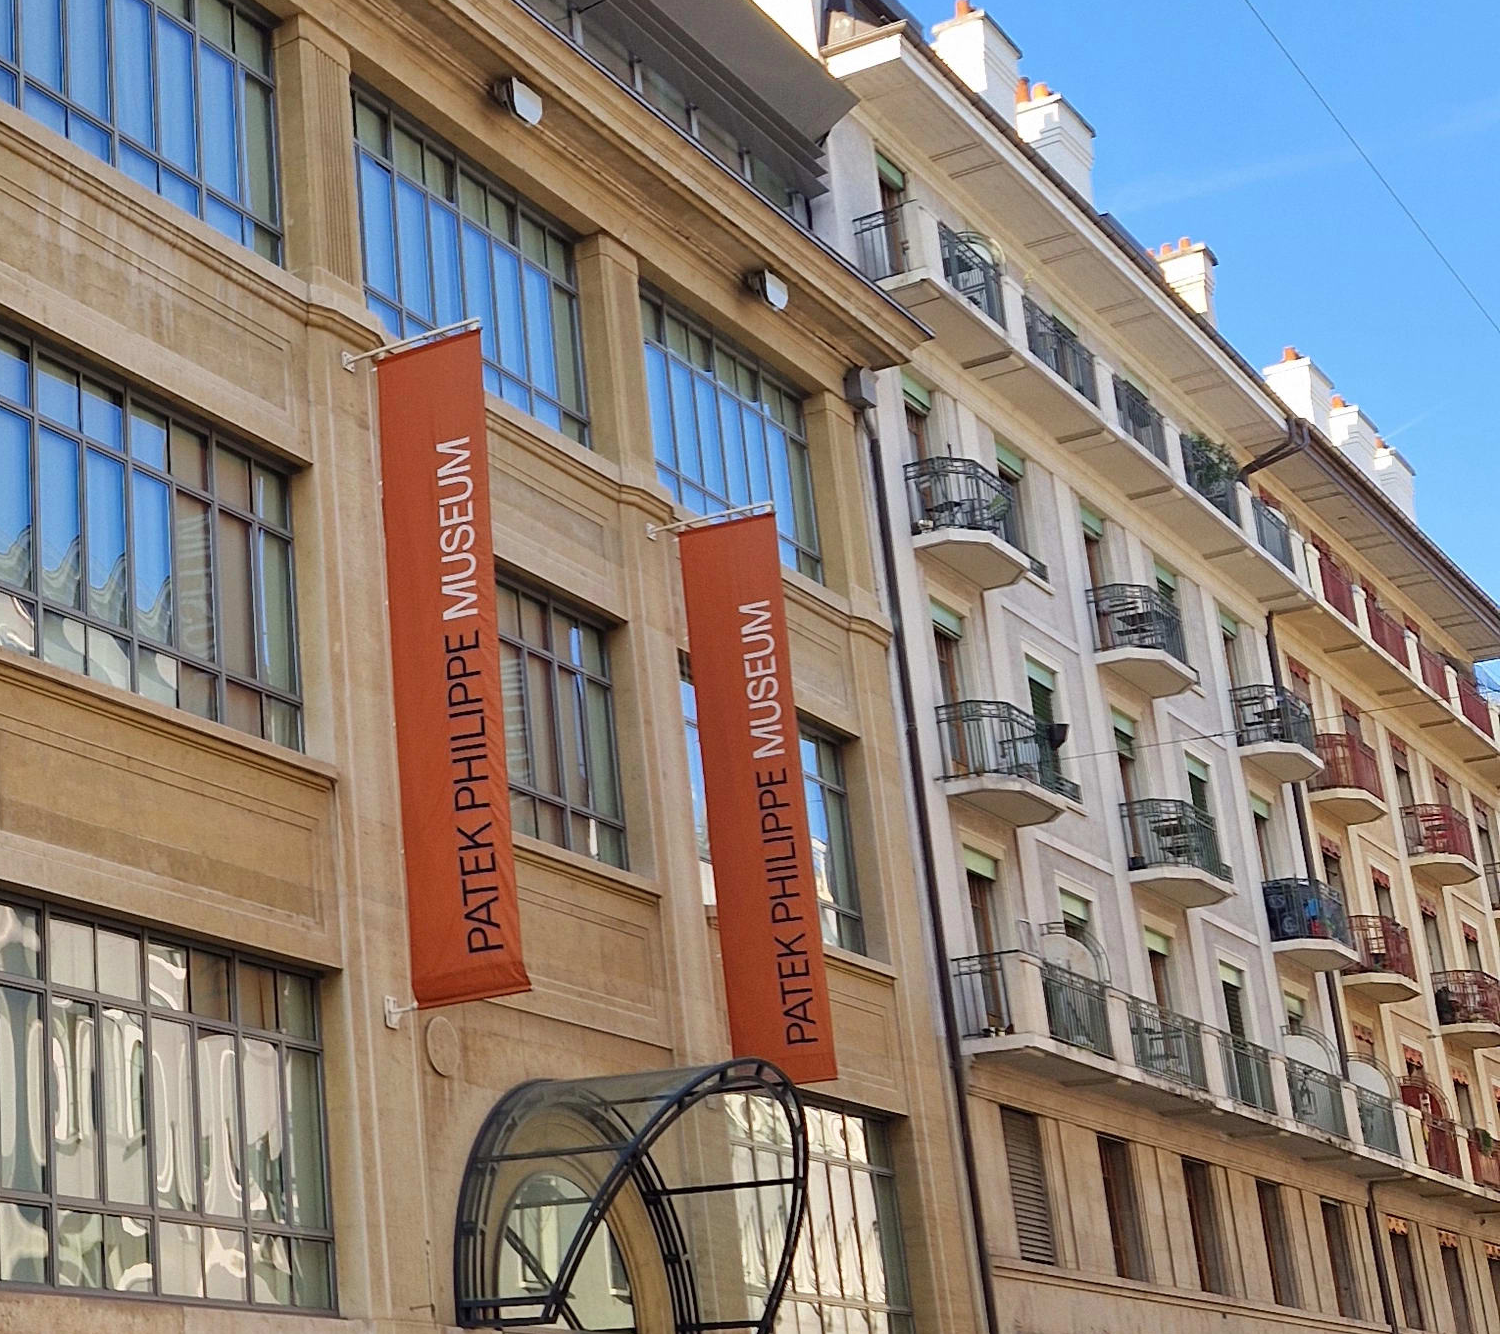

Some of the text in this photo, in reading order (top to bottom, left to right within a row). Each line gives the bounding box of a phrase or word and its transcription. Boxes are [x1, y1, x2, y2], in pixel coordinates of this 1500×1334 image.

[436, 436, 504, 954] PATEK PHILIPPE MUSEUM
[738, 600, 818, 1045] PATEK PHILIPPE MUSEUM
